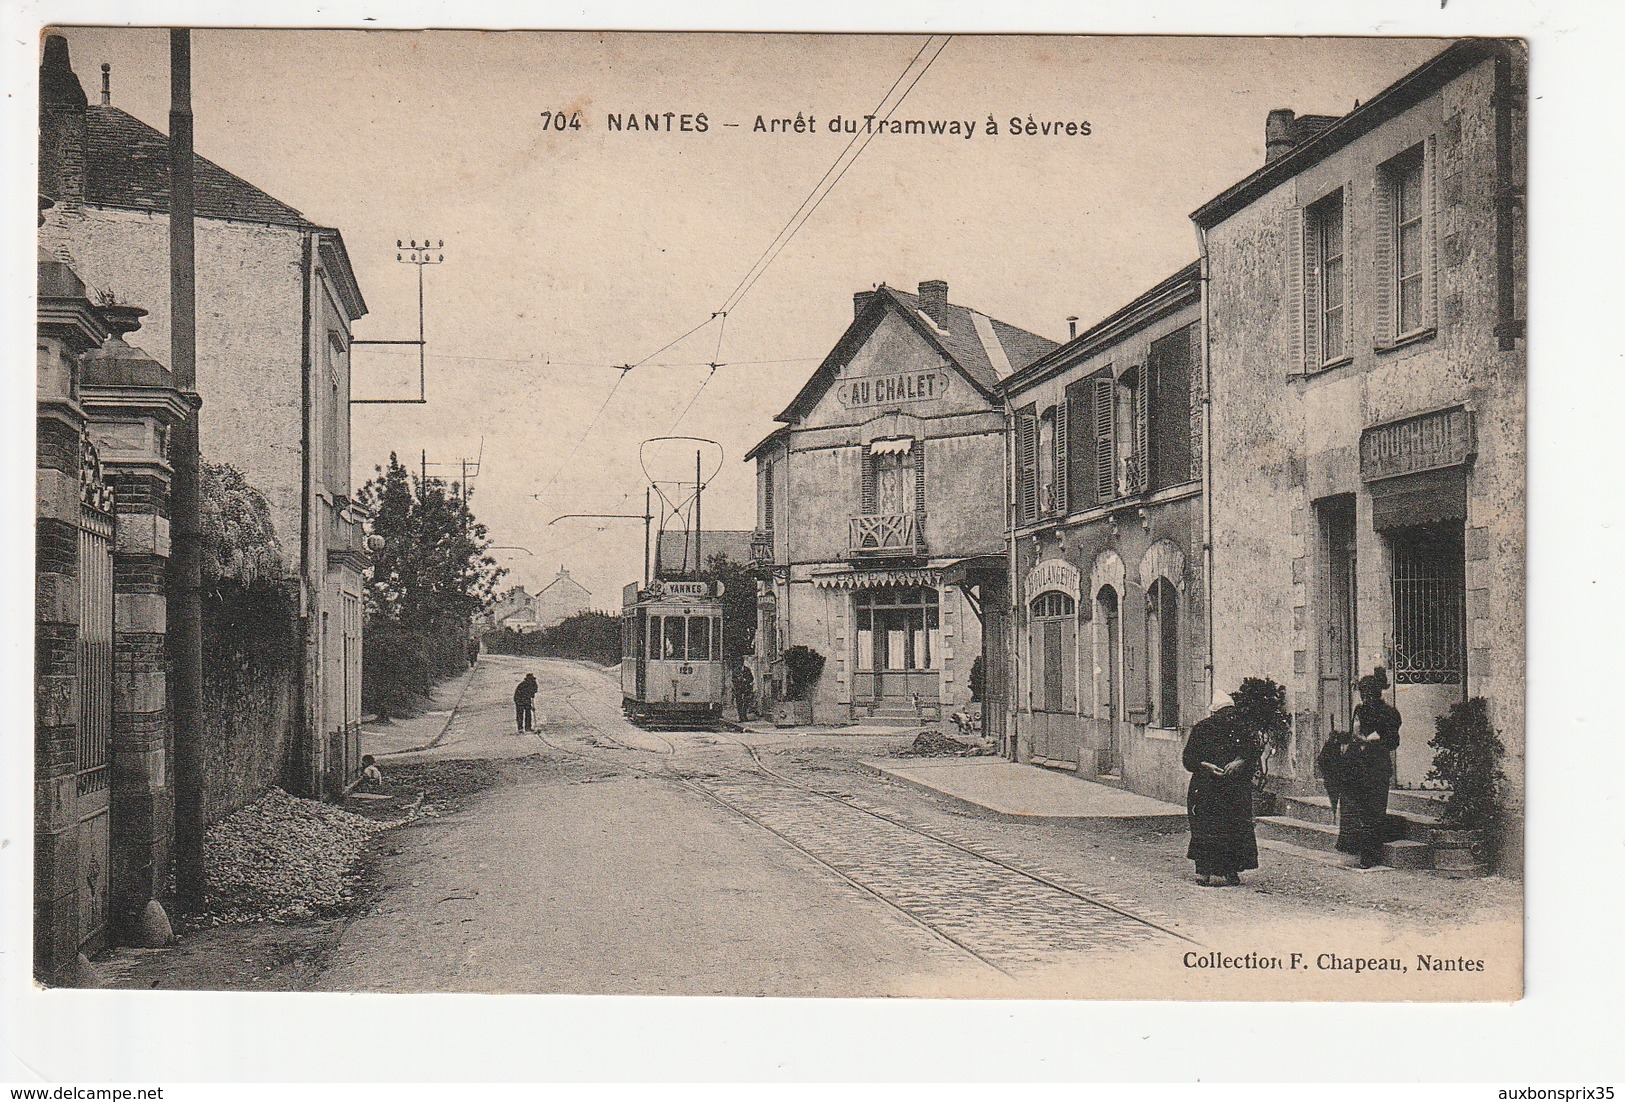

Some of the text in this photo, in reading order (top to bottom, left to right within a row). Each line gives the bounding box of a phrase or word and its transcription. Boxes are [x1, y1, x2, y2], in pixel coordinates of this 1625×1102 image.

[851, 373, 936, 405] AU CHALET
[669, 584, 702, 594] VANNES
